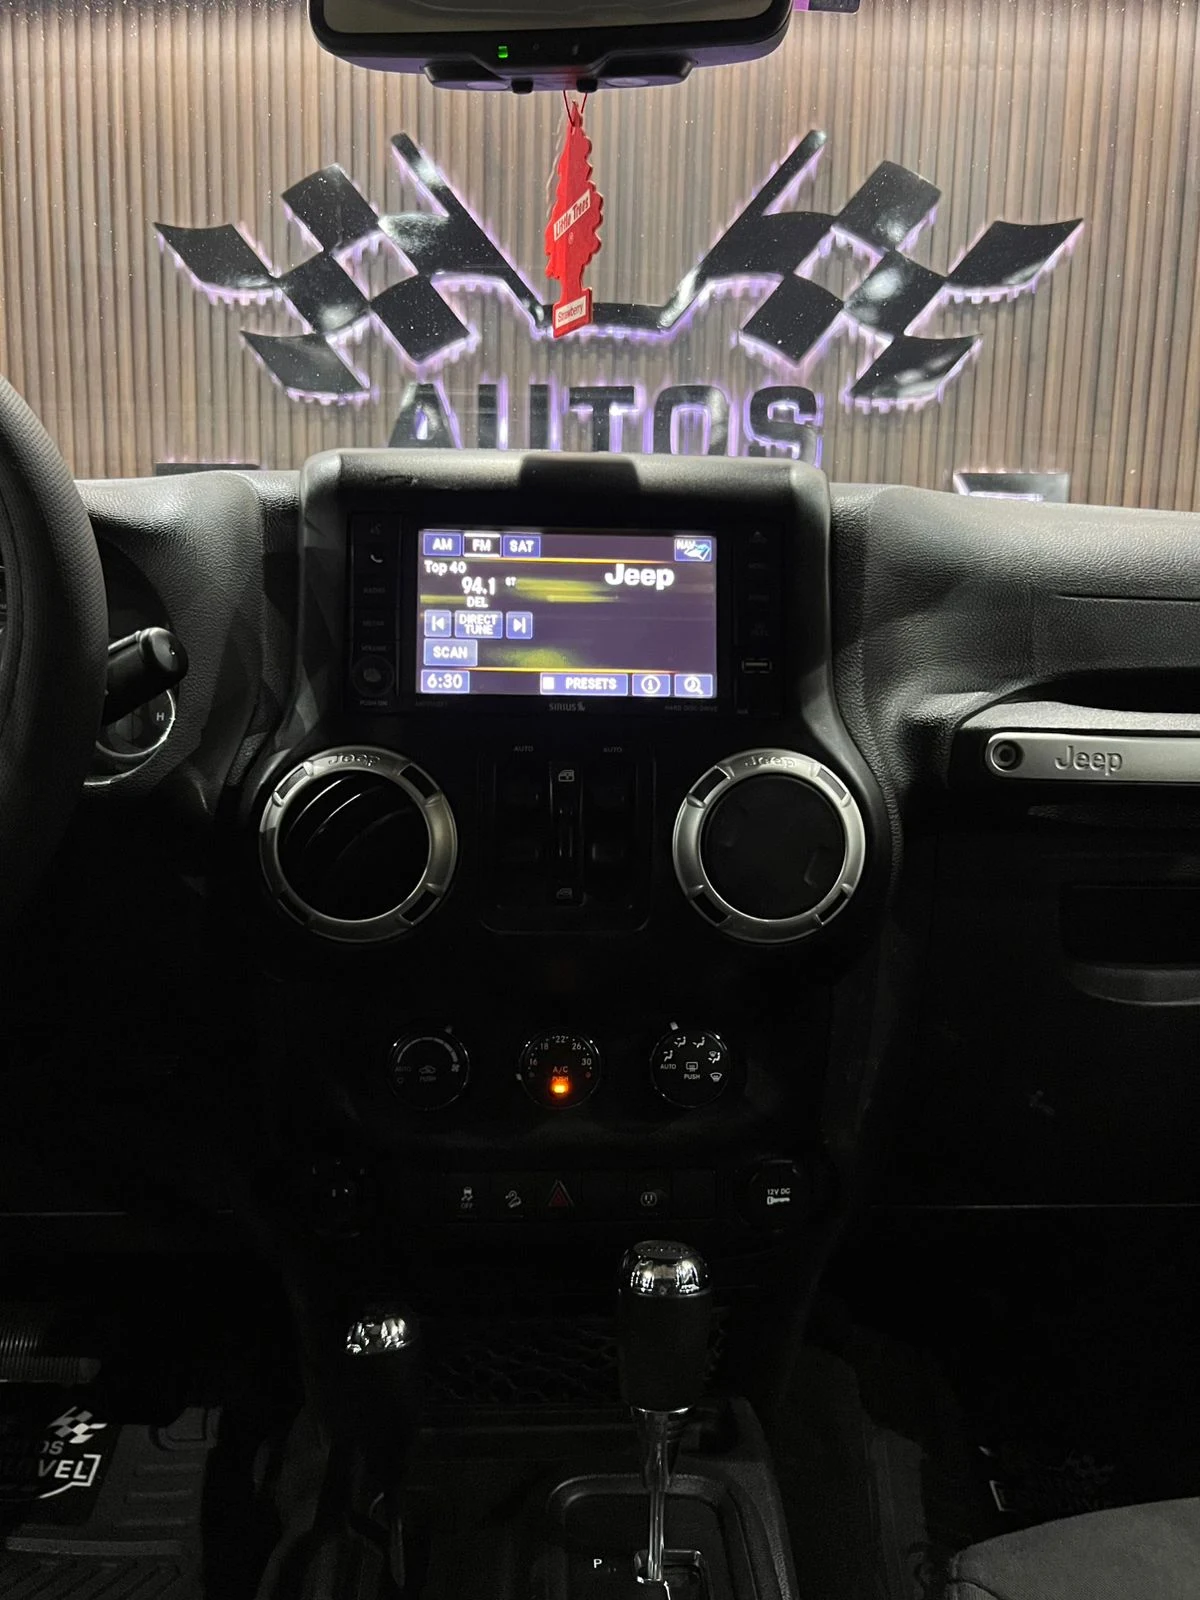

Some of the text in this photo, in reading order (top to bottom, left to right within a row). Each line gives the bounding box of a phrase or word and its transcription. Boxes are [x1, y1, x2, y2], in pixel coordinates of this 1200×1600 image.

[556, 196, 590, 237] Little Trees
[557, 304, 585, 324] Strawberry
[388, 382, 819, 455] AUTOS
[432, 537, 453, 551] AM
[472, 537, 492, 552] FM
[509, 539, 535, 553] SAT
[424, 559, 468, 576] Top 40
[604, 563, 675, 590] Jeep
[461, 576, 496, 595] 94.1
[466, 596, 489, 608] DEL
[458, 613, 498, 626] DIRECT
[464, 624, 495, 635] TUNE
[432, 646, 468, 659] SCAN
[427, 673, 463, 689] 6:30
[565, 677, 618, 691] PRESETS
[155, 711, 165, 721] H
[513, 745, 534, 753] AUTO
[1054, 745, 1123, 777] Jeep
[555, 1035, 566, 1044] 22
[572, 1042, 582, 1050] 26
[581, 1058, 592, 1066] 30
[552, 1065, 569, 1074] A/C
[767, 1187, 791, 1196] 12V DC
[593, 1557, 604, 1569] P
